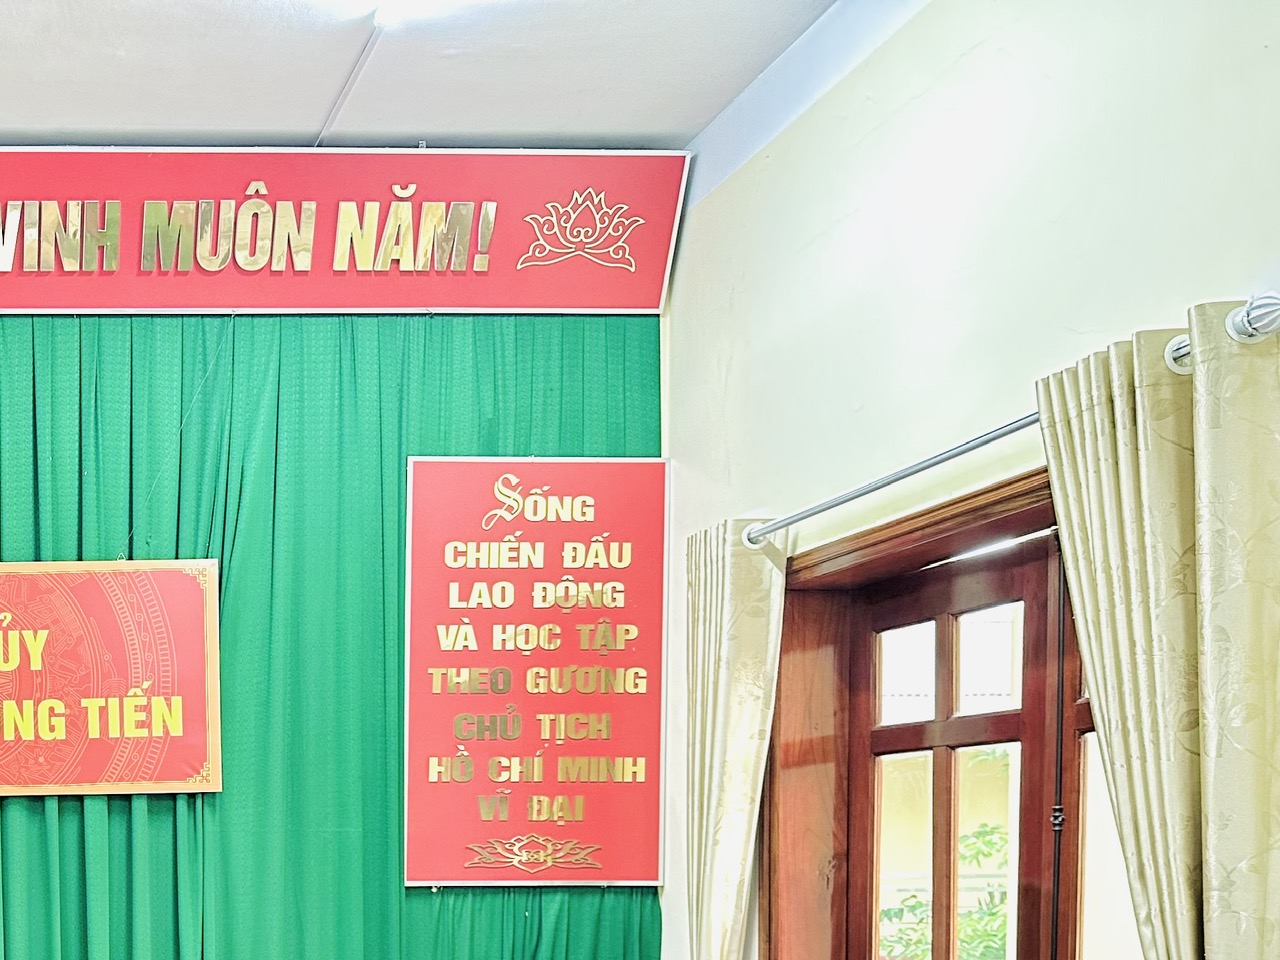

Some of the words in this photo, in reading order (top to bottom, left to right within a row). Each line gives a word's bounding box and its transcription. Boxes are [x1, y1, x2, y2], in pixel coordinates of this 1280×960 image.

[142, 181, 314, 272] MUÔN
[333, 182, 497, 272] NĂM!
[481, 473, 595, 530] SỐNG
[444, 531, 544, 569] CHIẾN
[561, 532, 632, 569] ĐẤU
[448, 581, 515, 609] LAO
[531, 575, 625, 614] ĐỘNG
[436, 617, 478, 651] VÀ
[493, 624, 561, 657] HỌC
[576, 617, 639, 656] TẬP
[427, 667, 512, 695] THEO
[526, 666, 648, 695] GƯƠNG
[80, 681, 185, 738] TIẾN
[453, 704, 521, 741] CHỦ
[536, 713, 611, 745] TỊCH
[427, 744, 474, 783] HỒ
[488, 749, 545, 783] CHÍ
[557, 756, 646, 783] MINH
[476, 788, 509, 822] VĨ
[528, 795, 585, 826] ĐẠI
